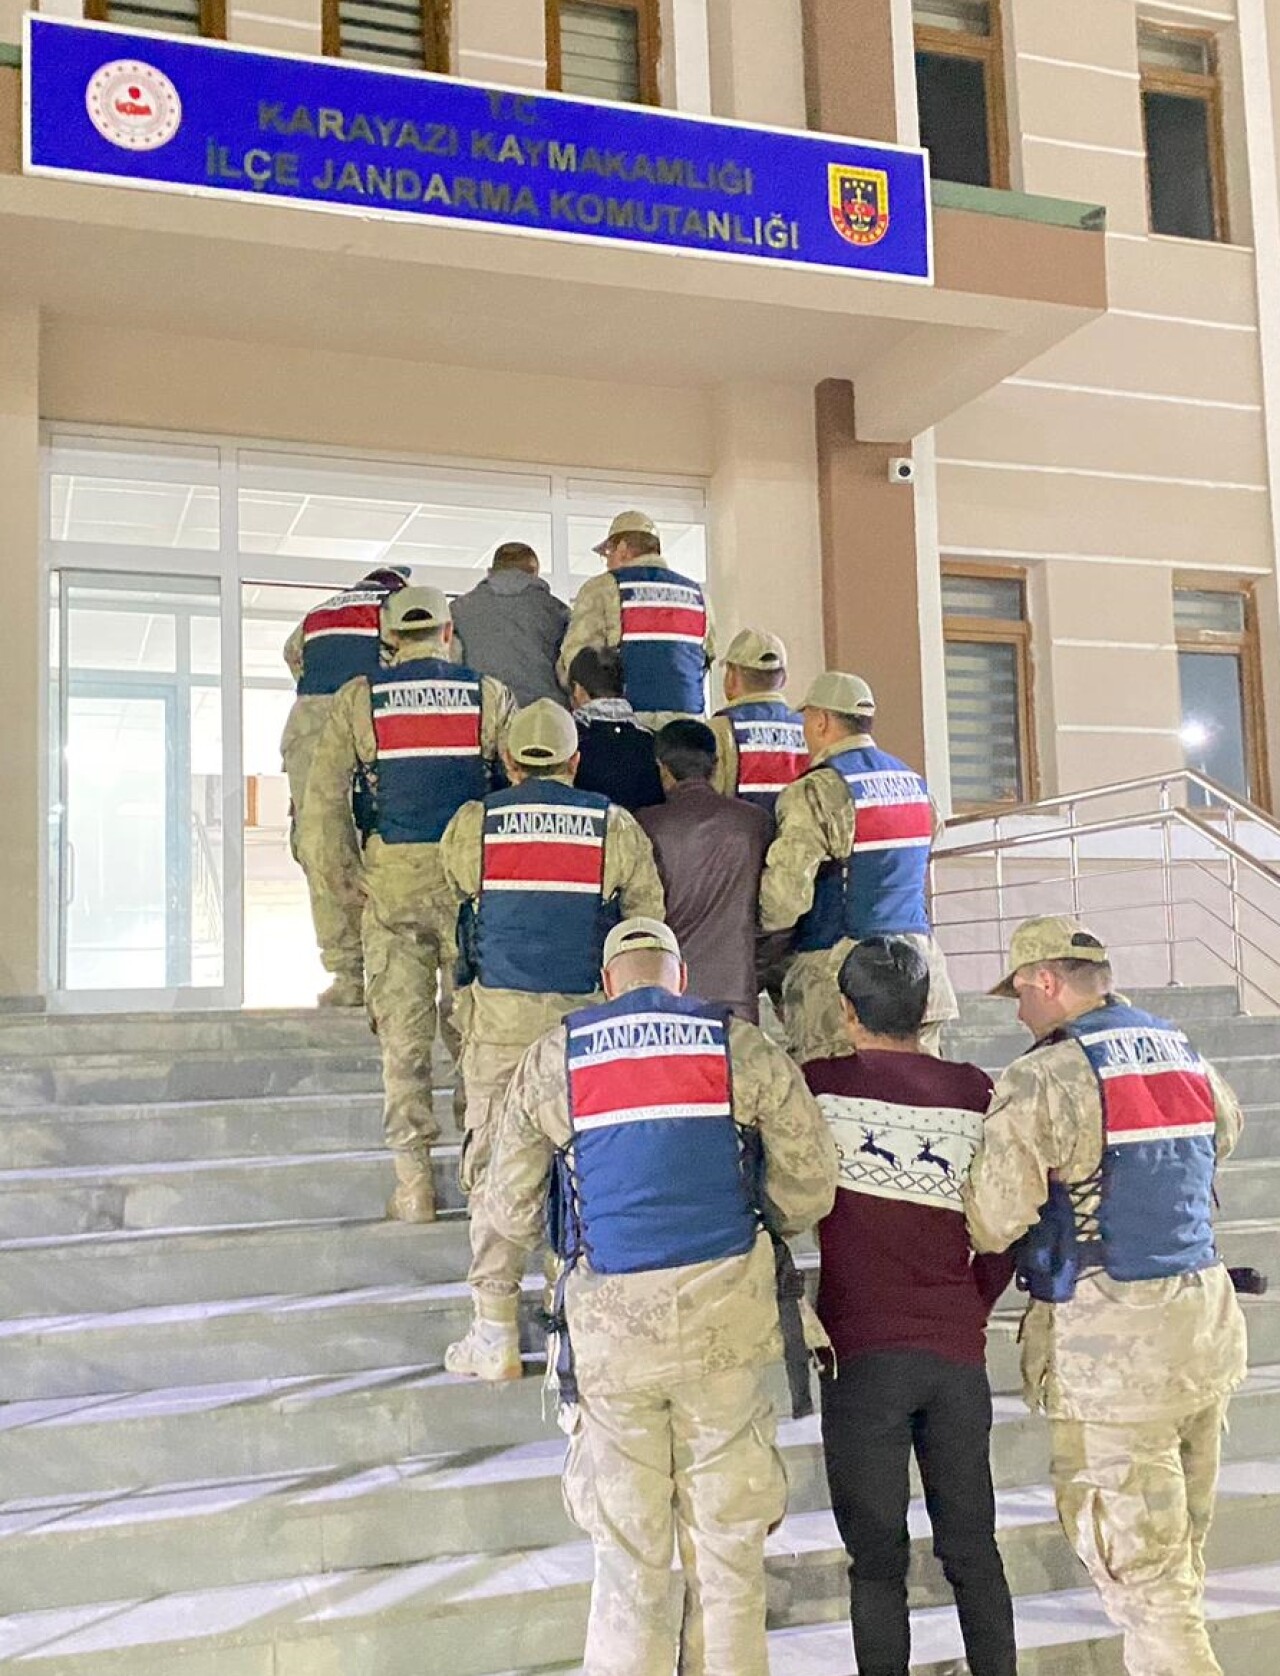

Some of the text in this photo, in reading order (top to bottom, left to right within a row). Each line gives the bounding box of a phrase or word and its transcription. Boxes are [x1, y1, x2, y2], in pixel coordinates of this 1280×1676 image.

[259, 100, 753, 195] KARAYAZI KAYMAKAMLIĞI
[206, 136, 299, 189] İLÇE
[313, 159, 538, 216] JANDARMA
[550, 190, 799, 250] KOMUTANLIĞI
[384, 688, 472, 707] JANDARMA
[497, 811, 595, 837] JANDARMA
[585, 1022, 716, 1055] JANDARMA
